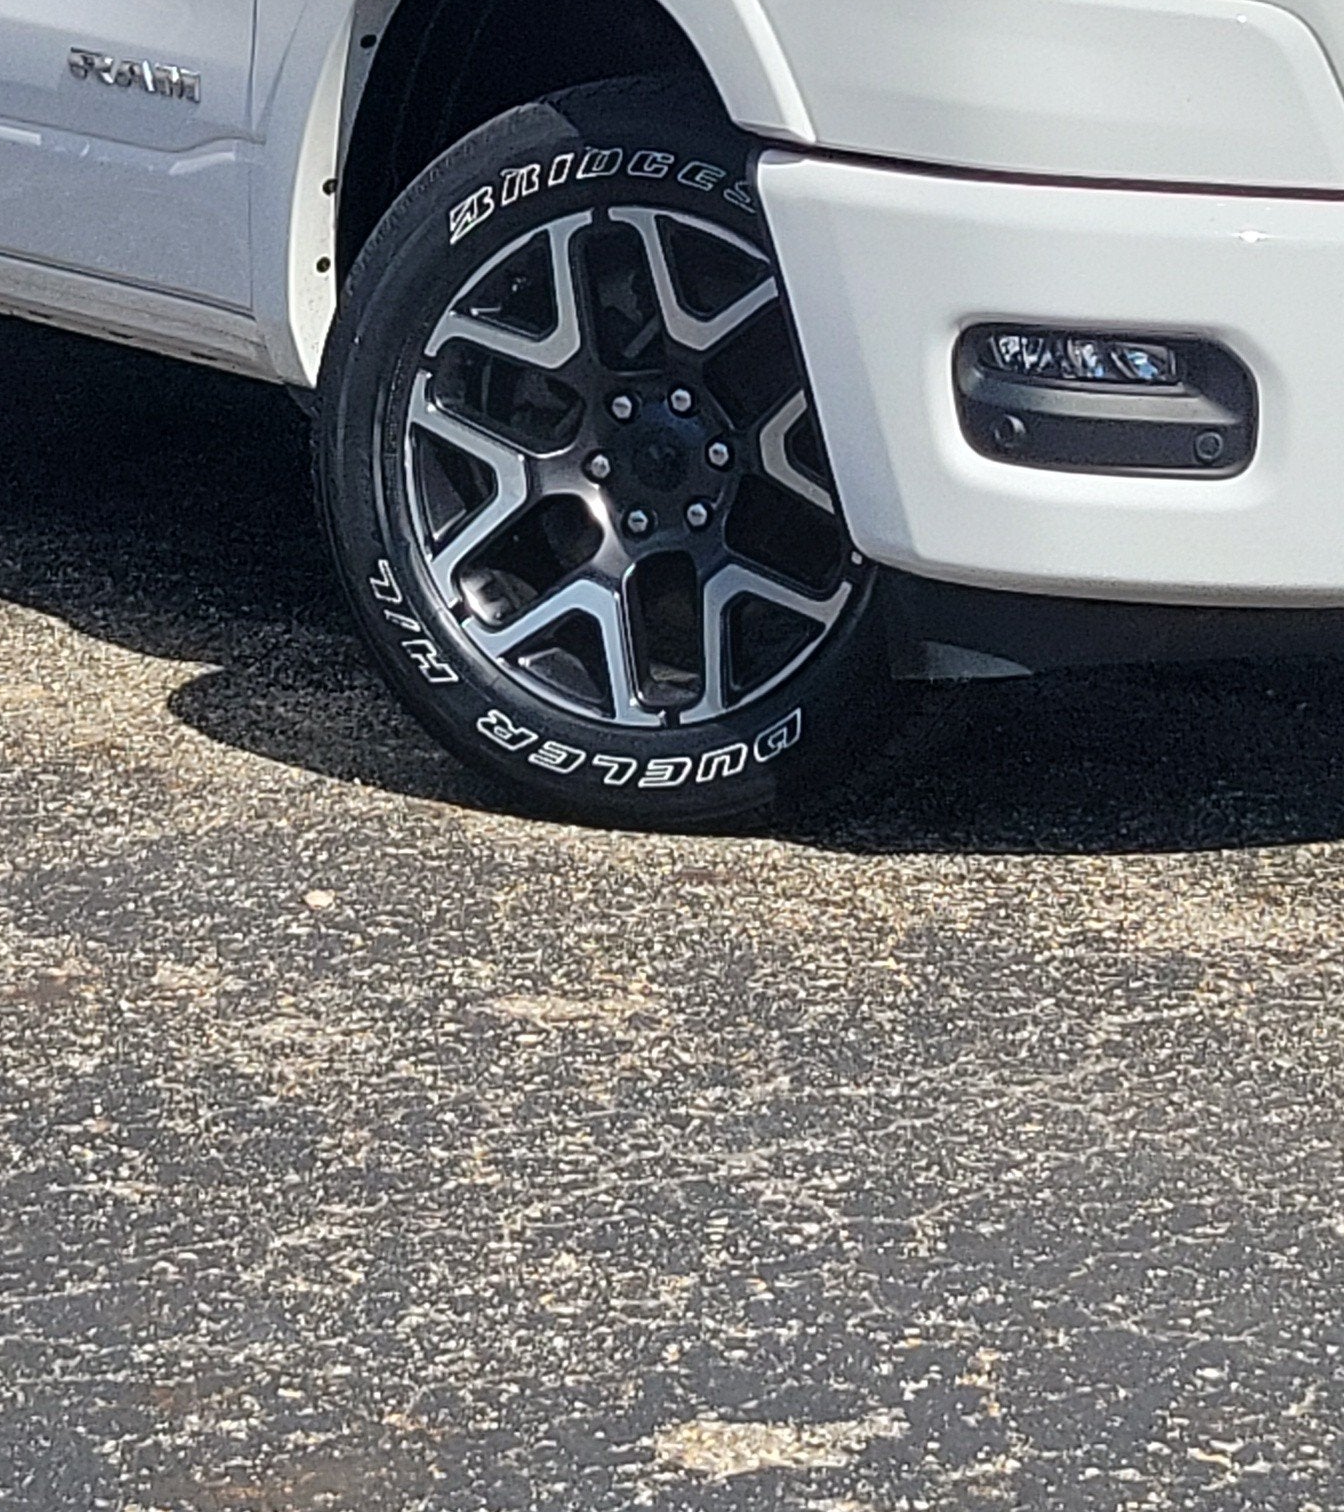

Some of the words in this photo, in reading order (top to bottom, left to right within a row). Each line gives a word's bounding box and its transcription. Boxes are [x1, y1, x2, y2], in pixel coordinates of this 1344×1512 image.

[67, 46, 201, 105] RAM
[449, 146, 756, 245] BRIDGES
[369, 558, 460, 684] H/L
[476, 707, 803, 789] DUELER
